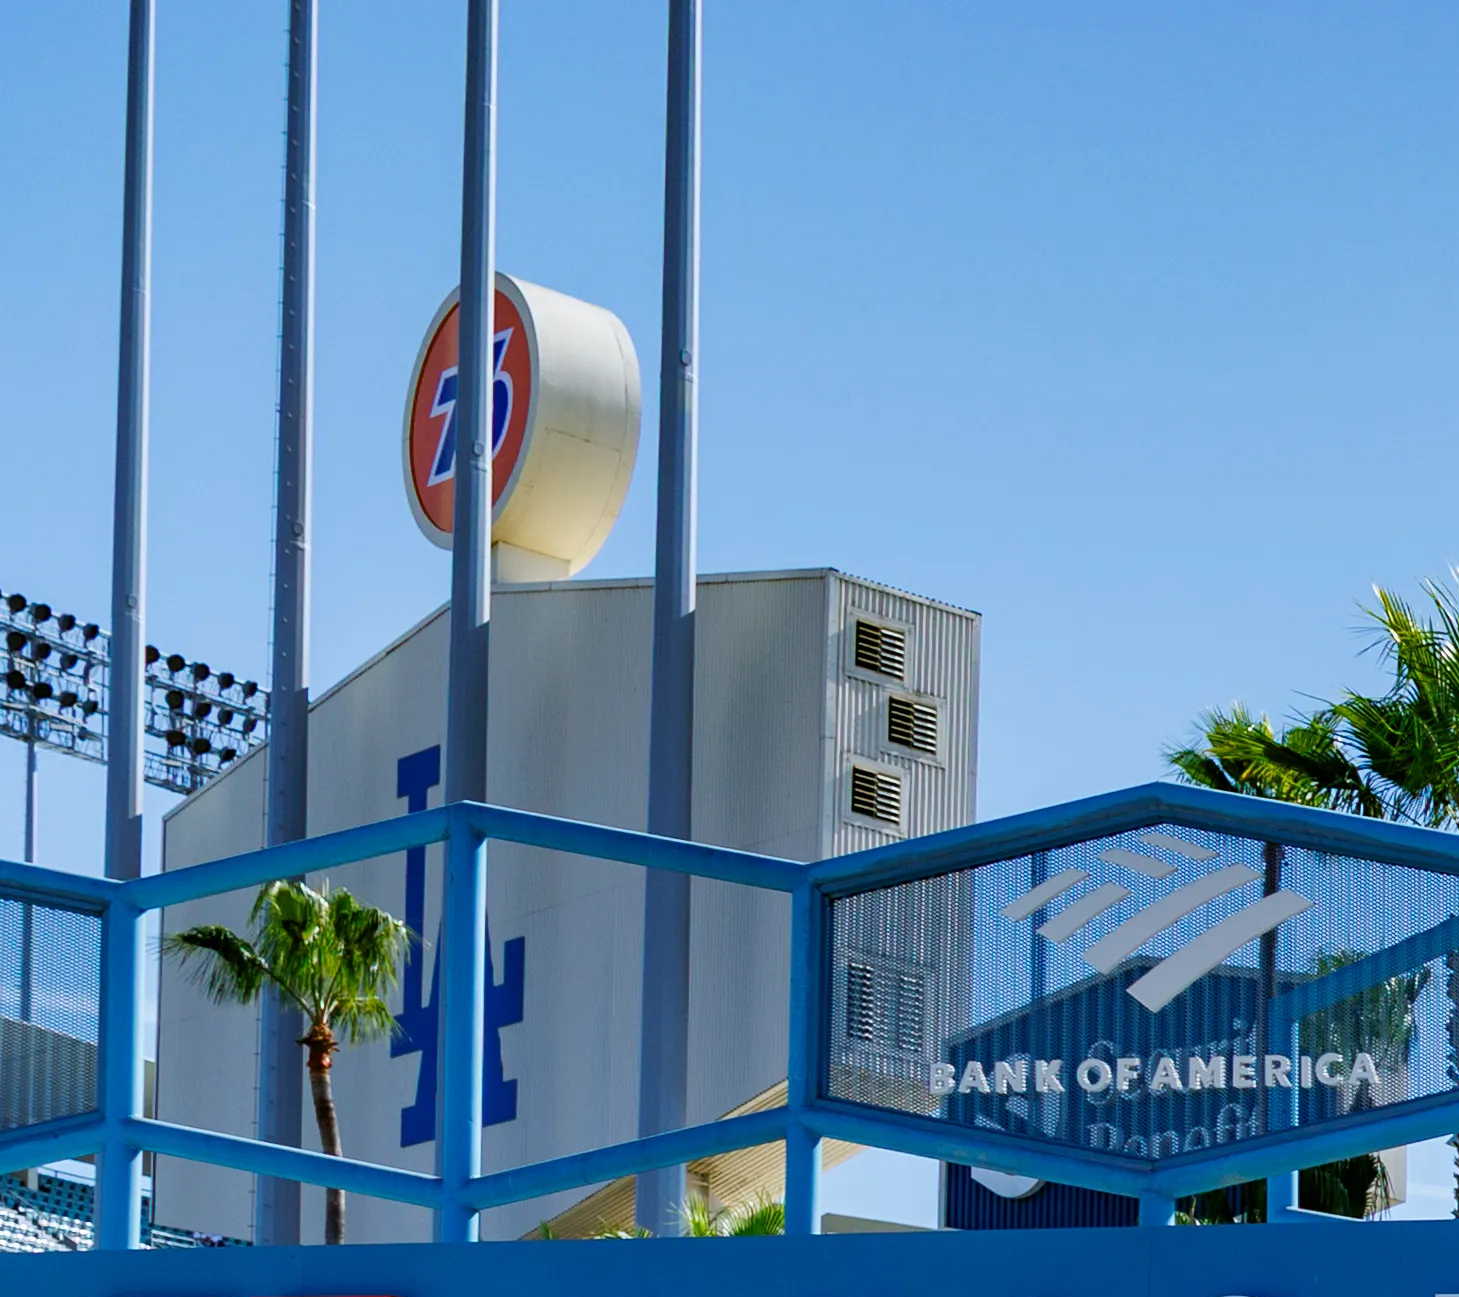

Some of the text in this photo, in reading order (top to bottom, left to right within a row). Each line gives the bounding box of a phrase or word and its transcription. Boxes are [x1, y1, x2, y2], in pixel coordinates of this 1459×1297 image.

[929, 1052, 1379, 1096] BANK OF AMERICA
